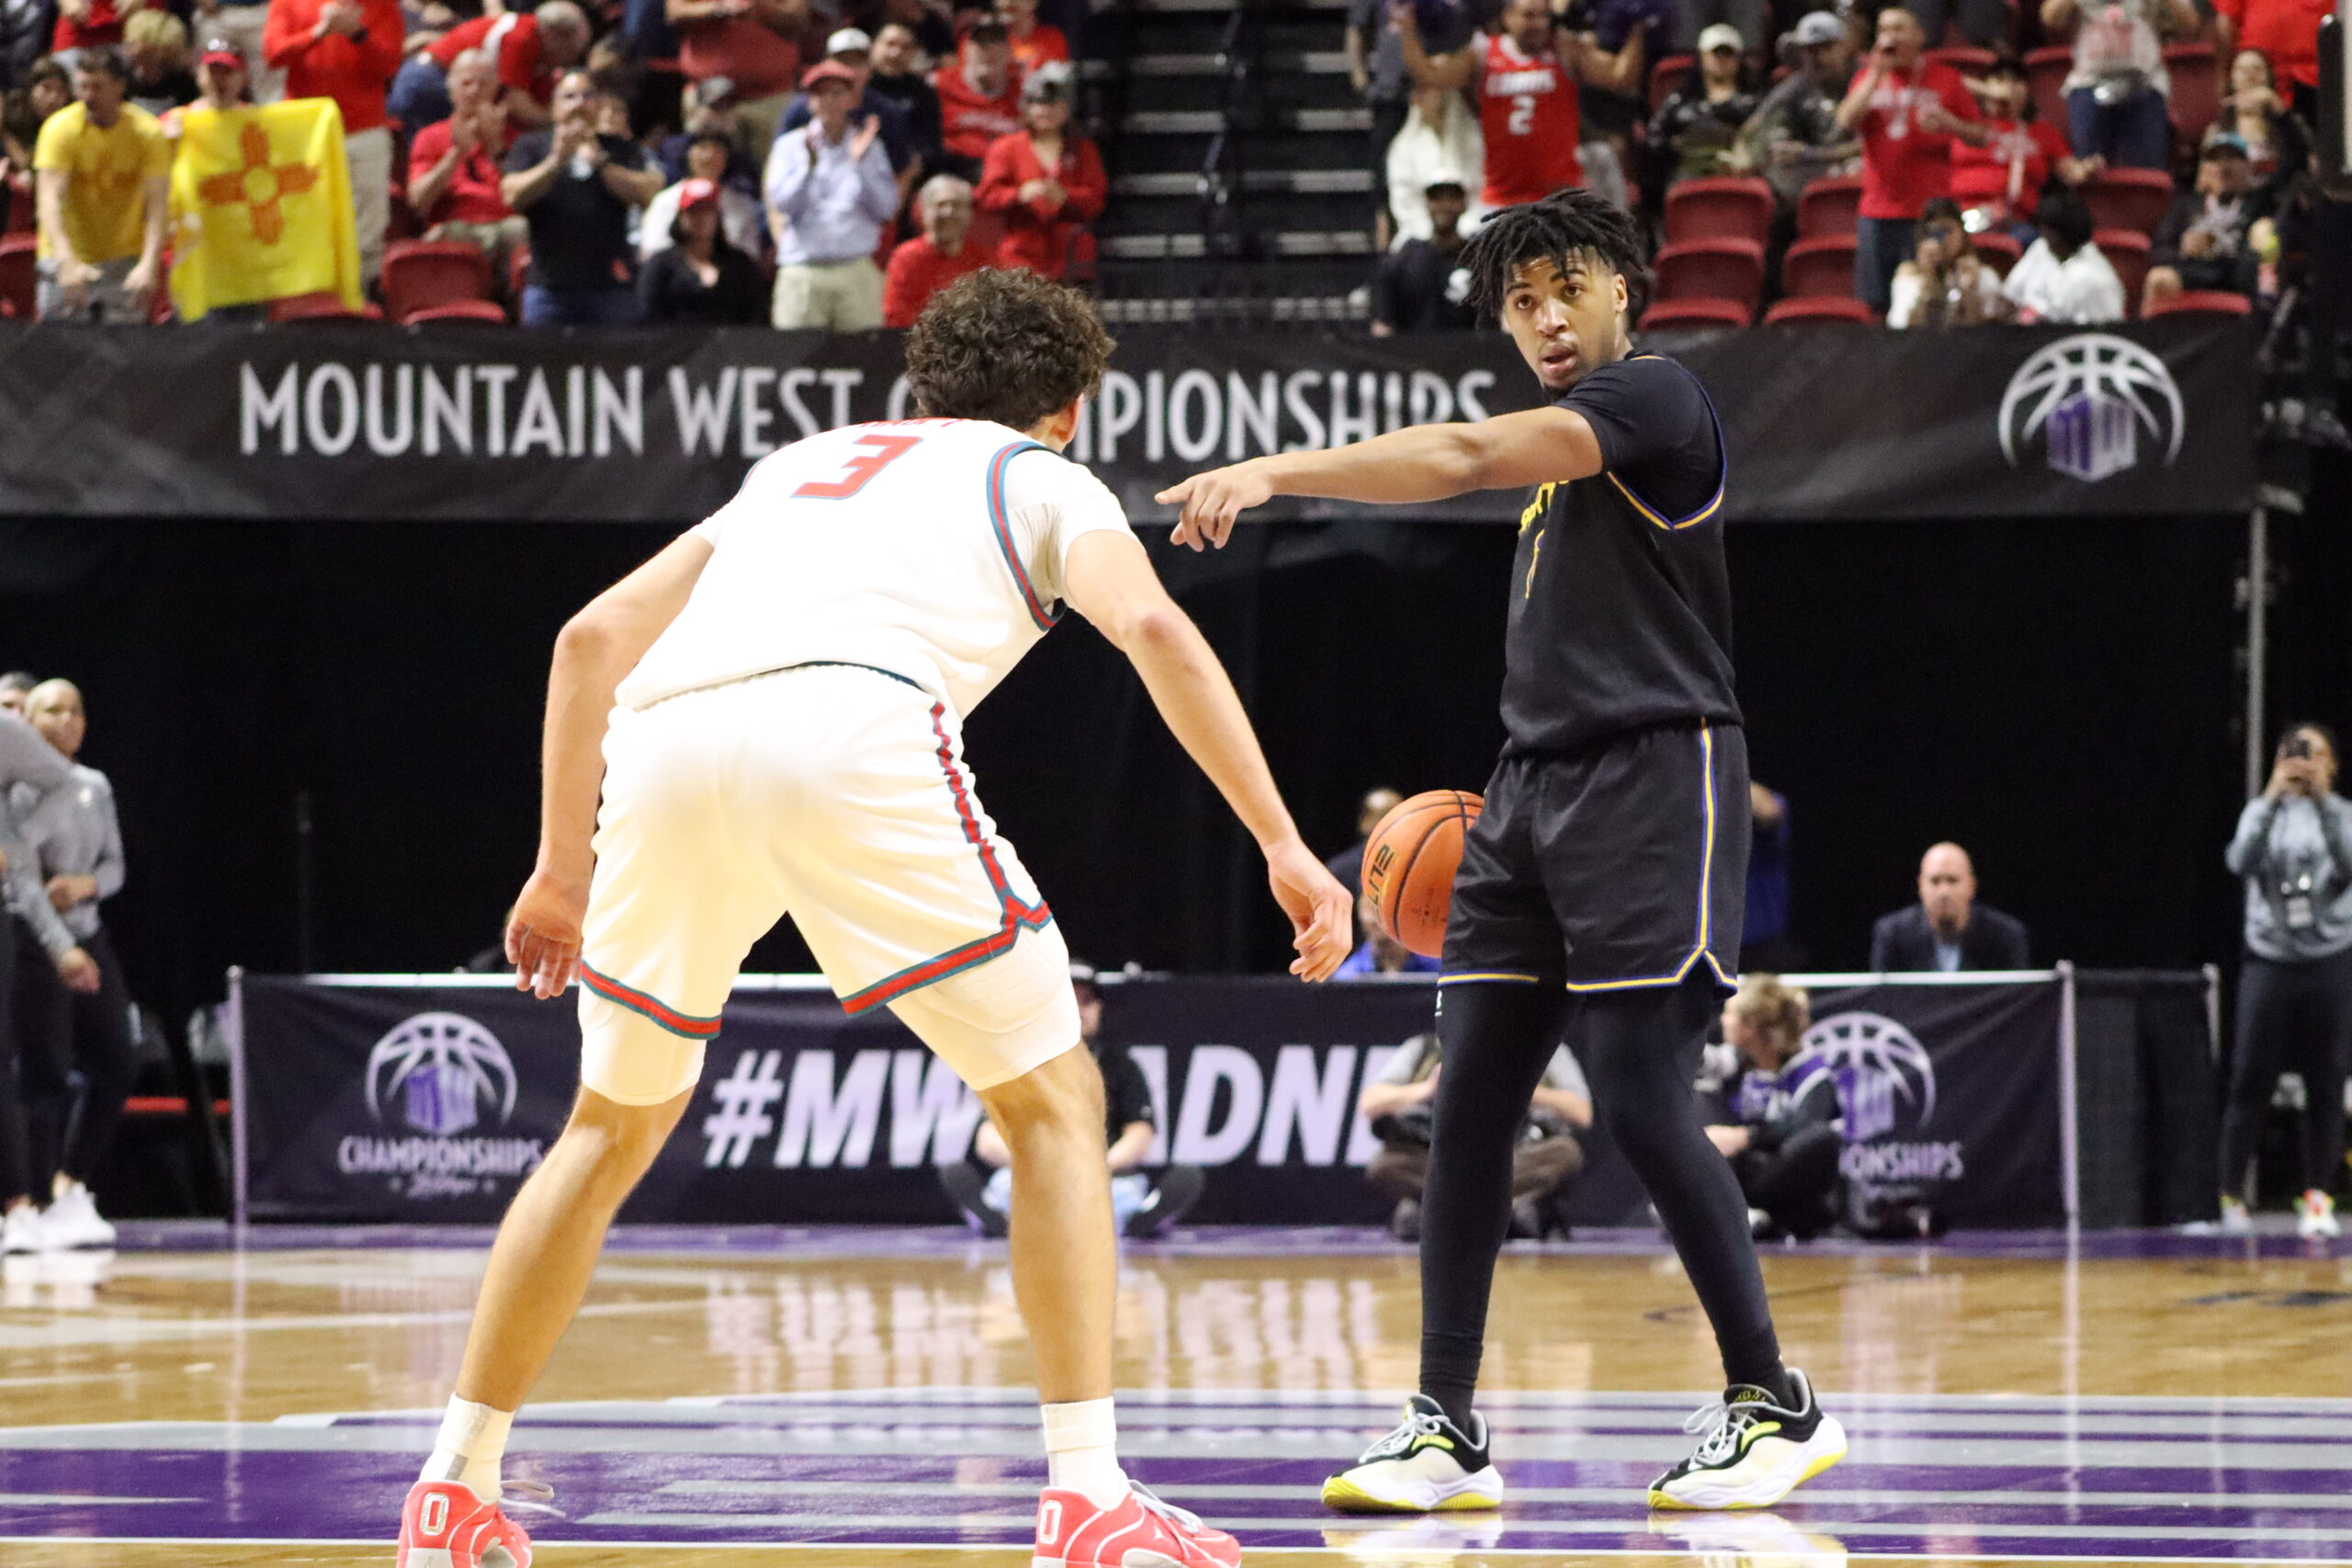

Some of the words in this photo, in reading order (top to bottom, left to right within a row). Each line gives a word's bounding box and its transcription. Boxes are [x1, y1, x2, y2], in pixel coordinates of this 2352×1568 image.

[240, 362, 643, 458] MOUNTAIN
[667, 366, 865, 458] WEST
[886, 369, 1497, 462] PIONSHIPS
[790, 434, 923, 500] 3
[1366, 843, 1396, 919] ELIT
[420, 1492, 449, 1536] 0
[1039, 1499, 1062, 1544] 0
